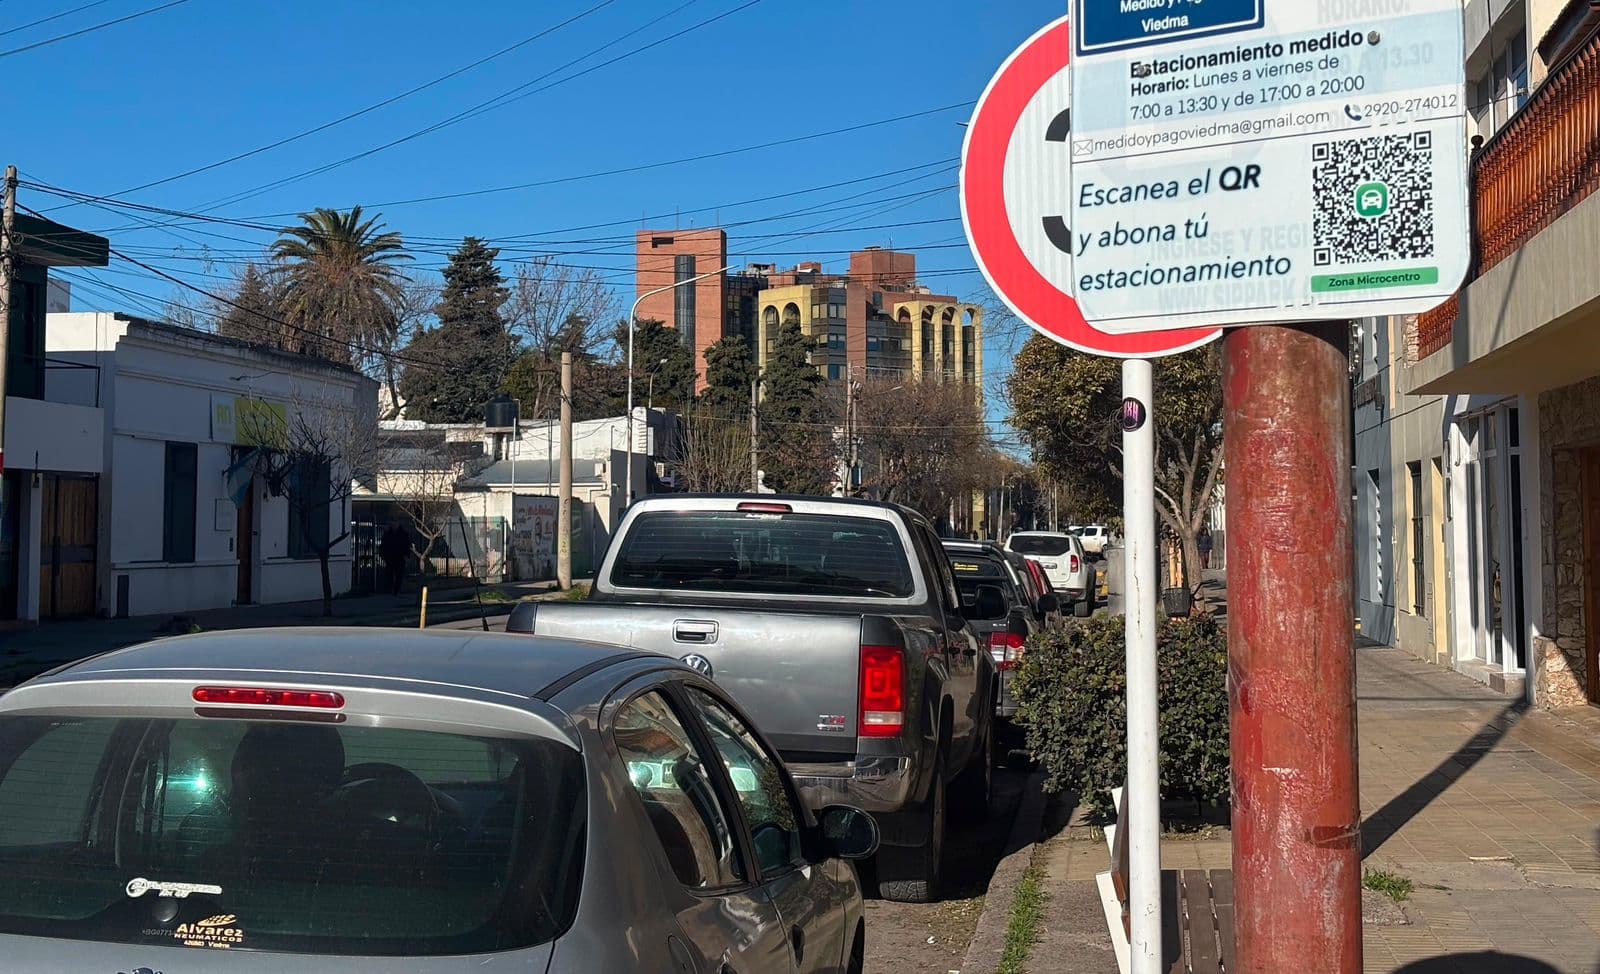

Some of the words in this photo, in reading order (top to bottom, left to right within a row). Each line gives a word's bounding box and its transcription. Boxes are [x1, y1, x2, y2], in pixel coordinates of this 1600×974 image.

[1141, 15, 1189, 33] Viedma
[1130, 43, 1283, 78] Estacionamiento
[1289, 30, 1364, 53] medido
[1130, 77, 1190, 97] Horario:
[1193, 72, 1238, 88] Lunes
[1243, 71, 1252, 81] a
[1256, 61, 1314, 79] viernes
[1318, 54, 1339, 70] de
[1130, 103, 1159, 120] 7:00
[1164, 105, 1173, 116] a
[1177, 95, 1216, 115] 13:30
[1220, 99, 1231, 112] y
[1234, 91, 1254, 107] de
[1259, 84, 1301, 104] 17:00
[1306, 86, 1316, 98] a
[1320, 75, 1365, 95] 20:00
[1094, 112, 1330, 151] medidoypagoviedma@gmail.com
[1364, 94, 1458, 118] 2920-274012
[1078, 178, 1179, 208] Escanea
[1187, 167, 1210, 196] el
[1218, 163, 1261, 193] QR
[1076, 230, 1092, 258] y
[1099, 224, 1176, 250] abona
[1184, 212, 1209, 239] tú
[1079, 254, 1292, 292] estacionamiento
[1328, 277, 1353, 288] Zona
[1356, 273, 1421, 285] Microcentro
[174, 933, 243, 943] NEUMATICOS
[176, 923, 244, 938] Alvarez
